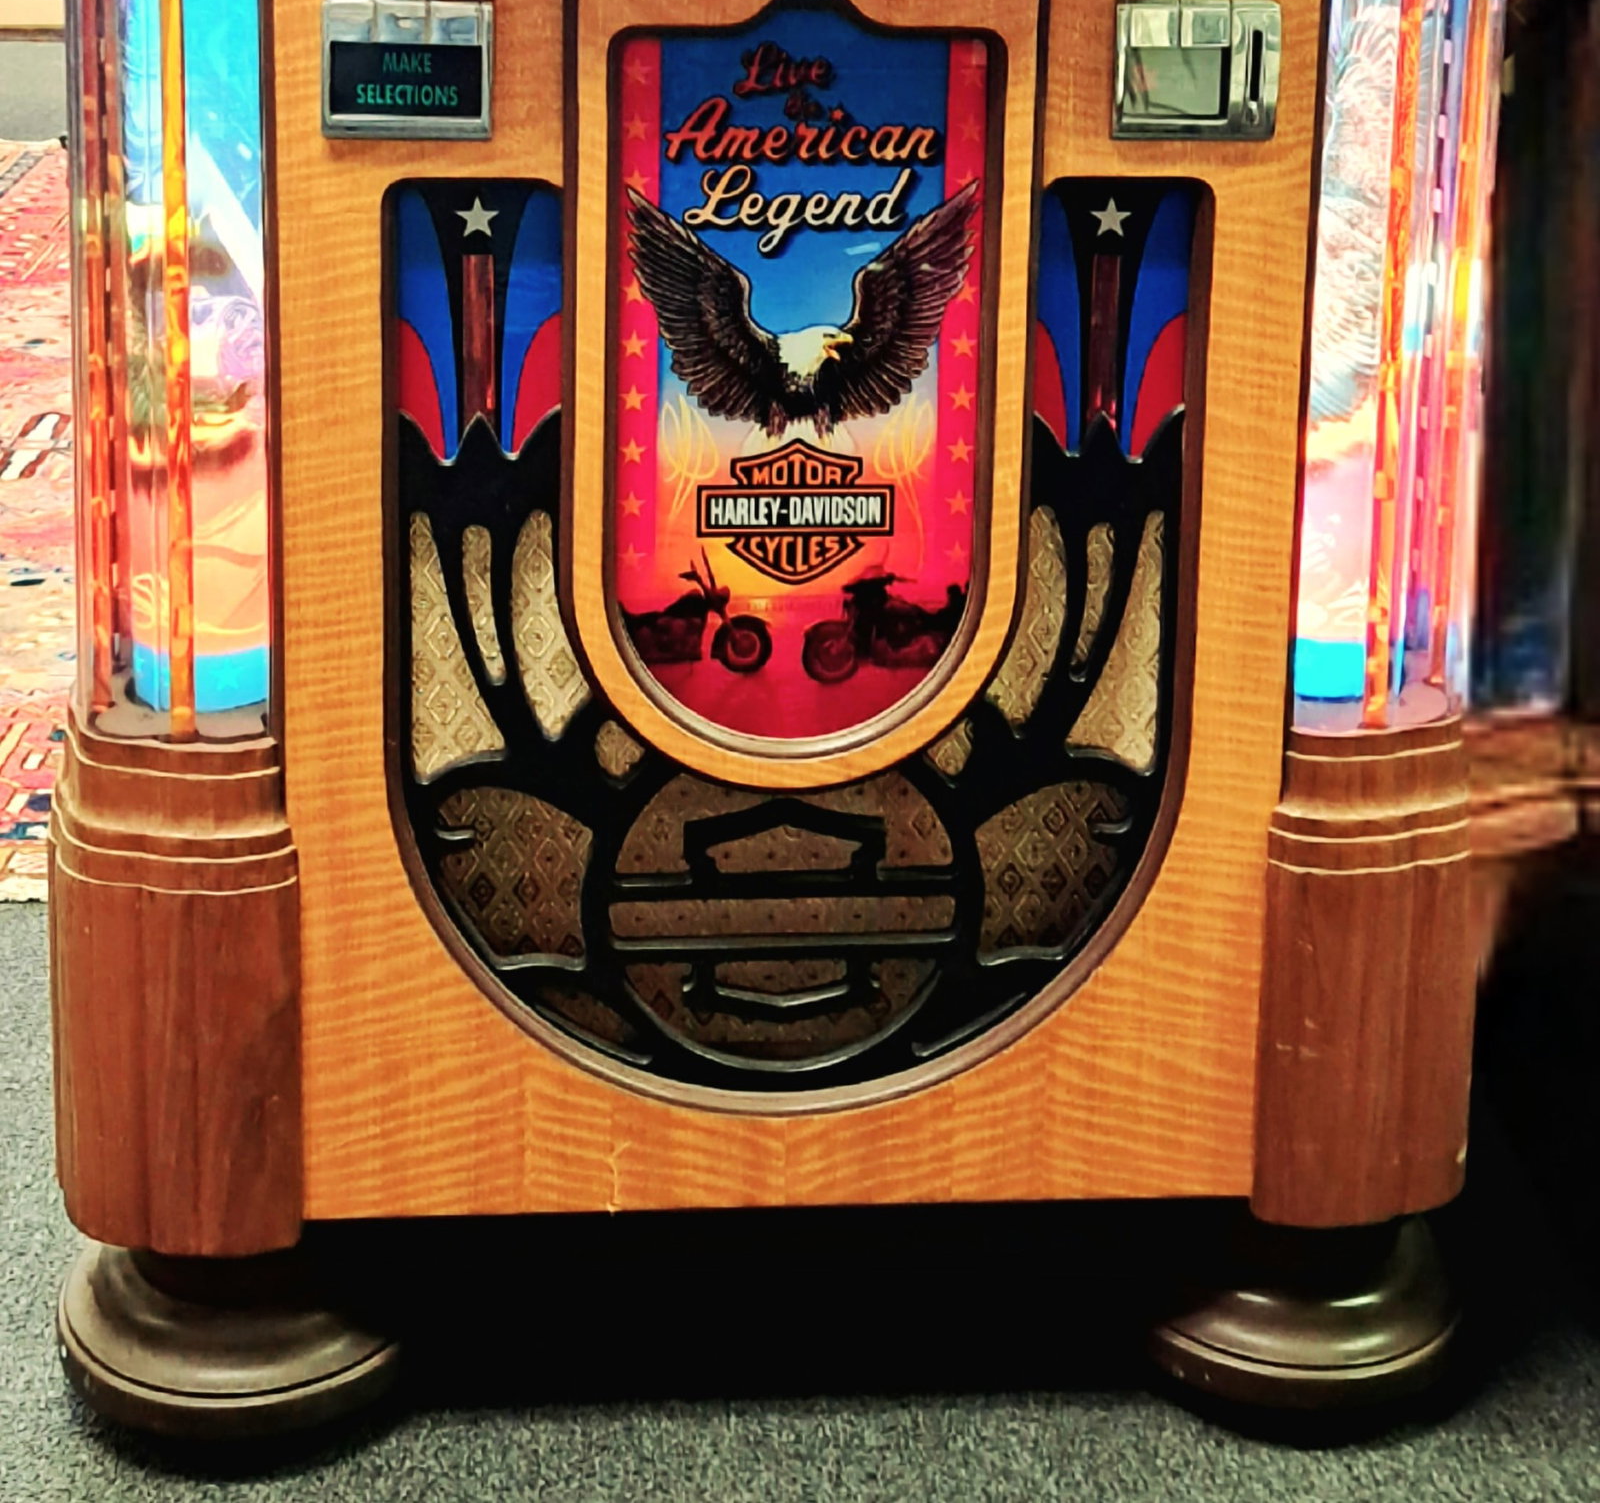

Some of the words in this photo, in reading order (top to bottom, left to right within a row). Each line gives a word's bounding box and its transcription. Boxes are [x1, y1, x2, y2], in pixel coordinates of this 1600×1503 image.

[382, 52, 433, 74] MAKE
[734, 43, 833, 96] Live
[356, 84, 459, 108] SELECTIONS
[664, 96, 938, 162] American
[683, 164, 914, 255] Legend
[752, 453, 843, 486] MOTOR
[709, 496, 882, 527] HARLEY-DAVIDSON
[749, 536, 841, 573] CYCLES
